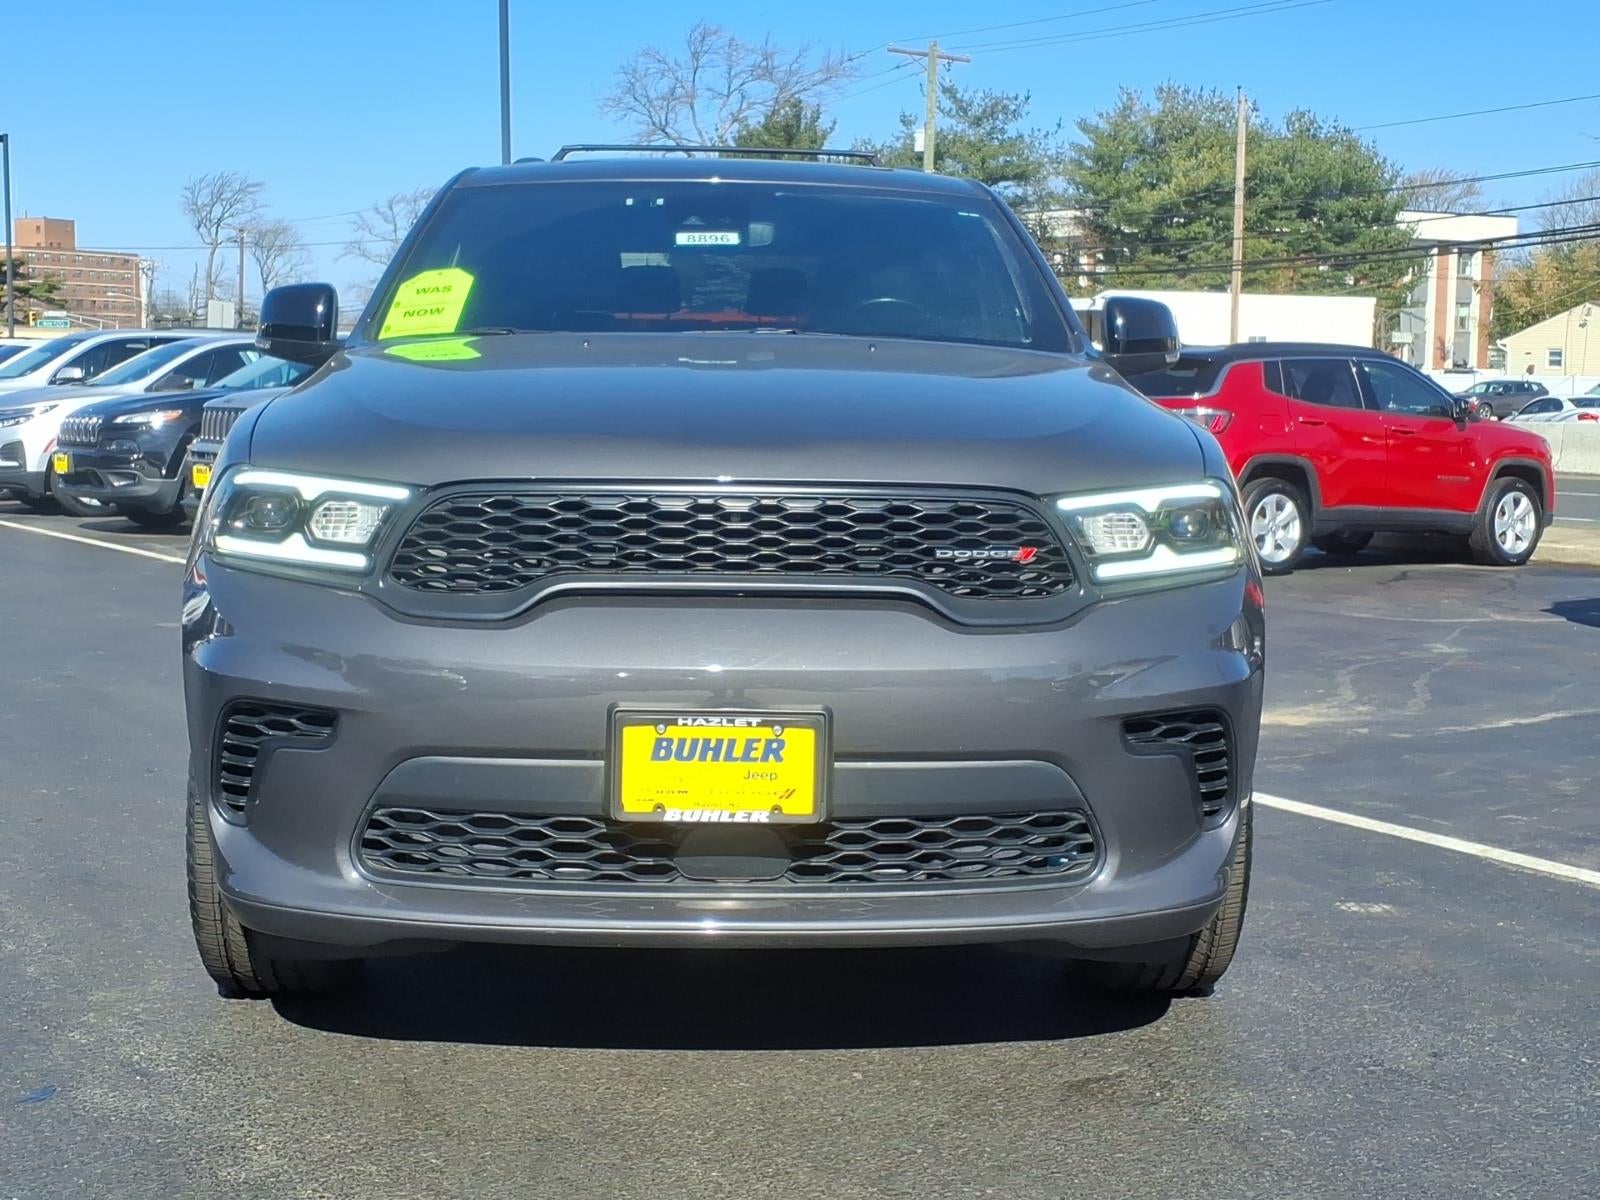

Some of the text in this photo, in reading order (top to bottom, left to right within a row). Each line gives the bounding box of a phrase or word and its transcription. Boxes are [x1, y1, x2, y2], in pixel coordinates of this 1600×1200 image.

[686, 234, 731, 244] 8896
[415, 285, 453, 295] WAS
[403, 307, 445, 318] NOW
[935, 549, 1020, 559] DODGE
[677, 717, 762, 727] HAZLET
[650, 737, 786, 763] BUHLER
[743, 769, 778, 782] Jeep
[663, 809, 770, 823] BUHLER
